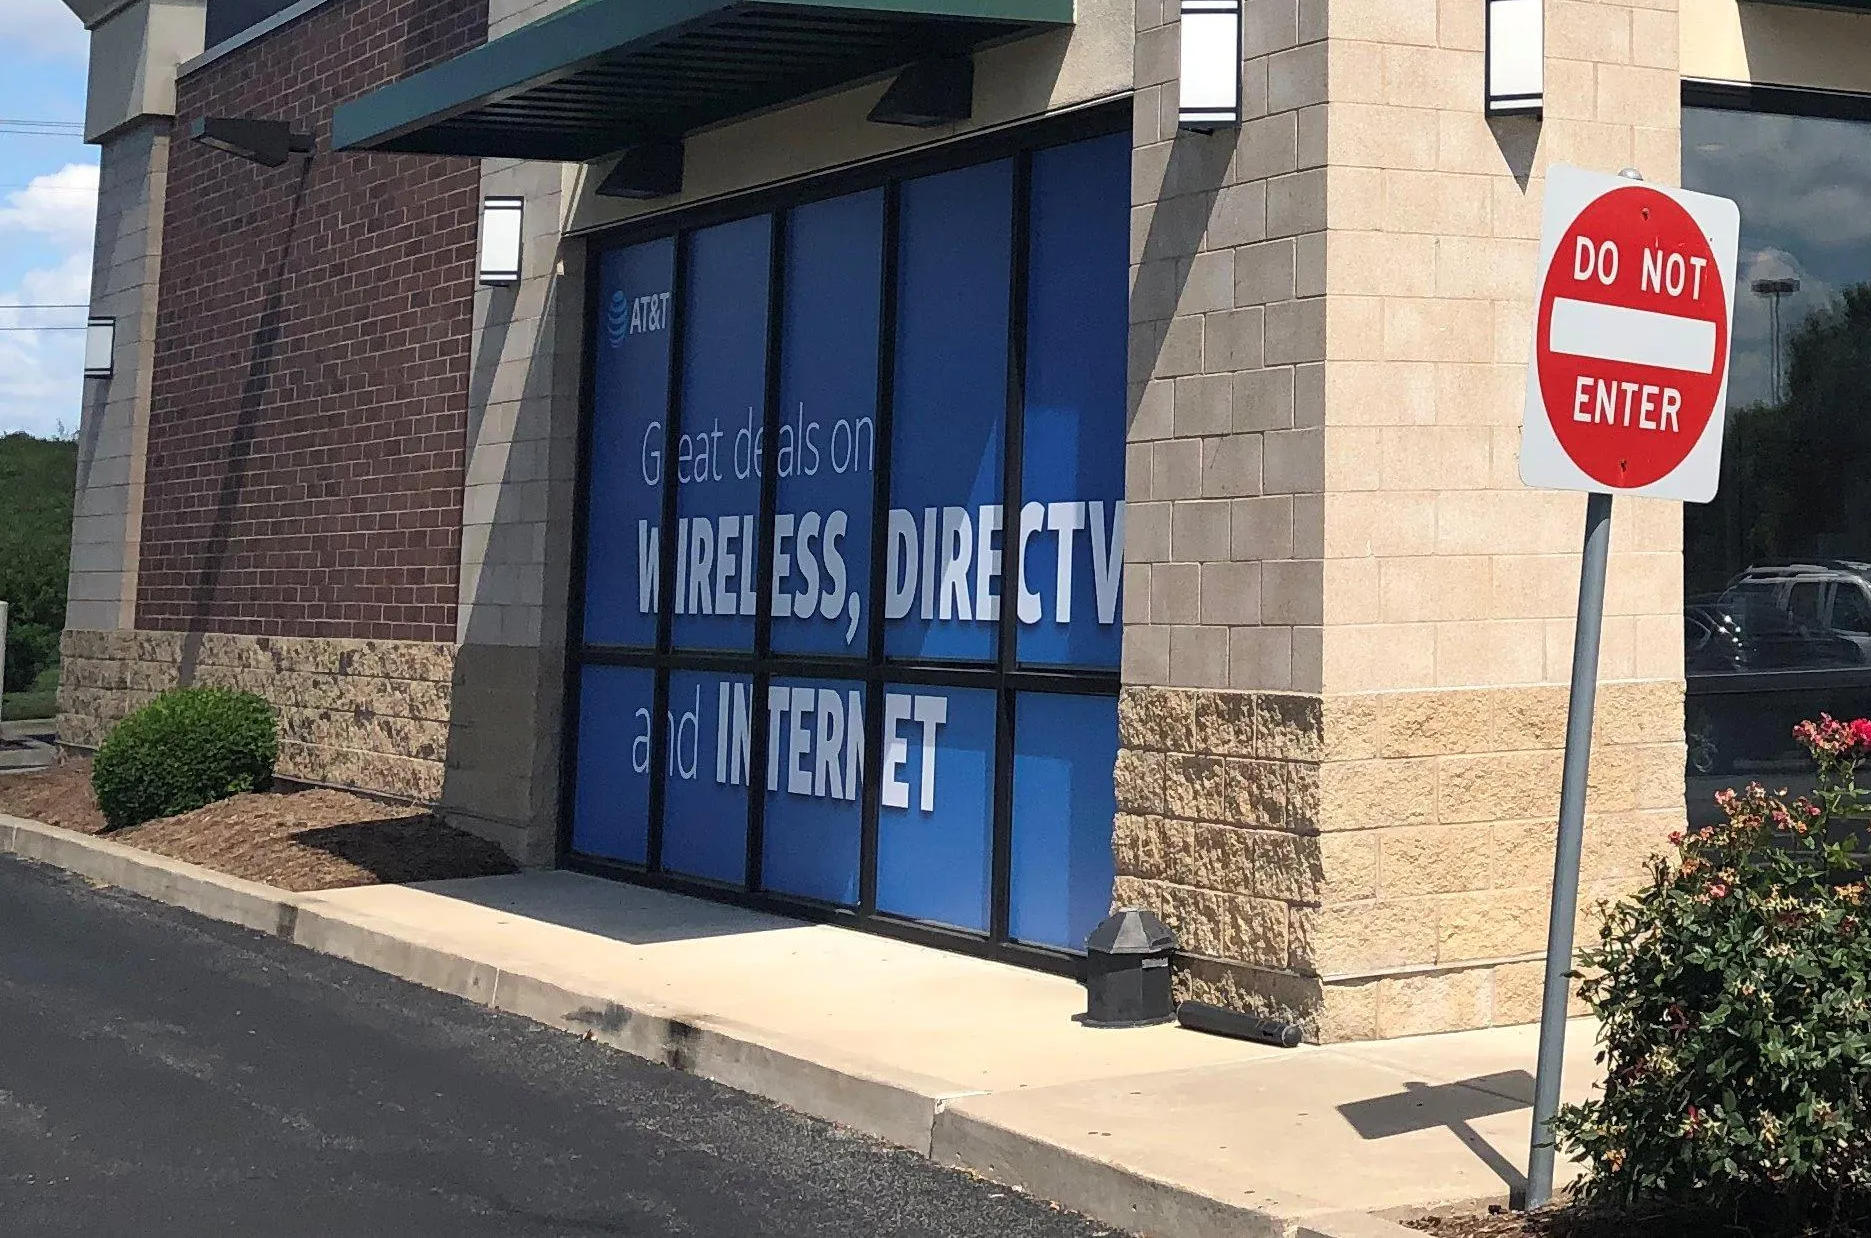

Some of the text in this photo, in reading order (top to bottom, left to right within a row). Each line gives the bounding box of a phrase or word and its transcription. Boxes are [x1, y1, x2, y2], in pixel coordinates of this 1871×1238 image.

[1573, 236, 1707, 300] DO NOT
[630, 291, 671, 335] AT&T
[1573, 375, 1681, 433] ENTER
[642, 418, 723, 486] Geat
[831, 416, 874, 474] on
[885, 499, 1126, 625] DIRECTV
